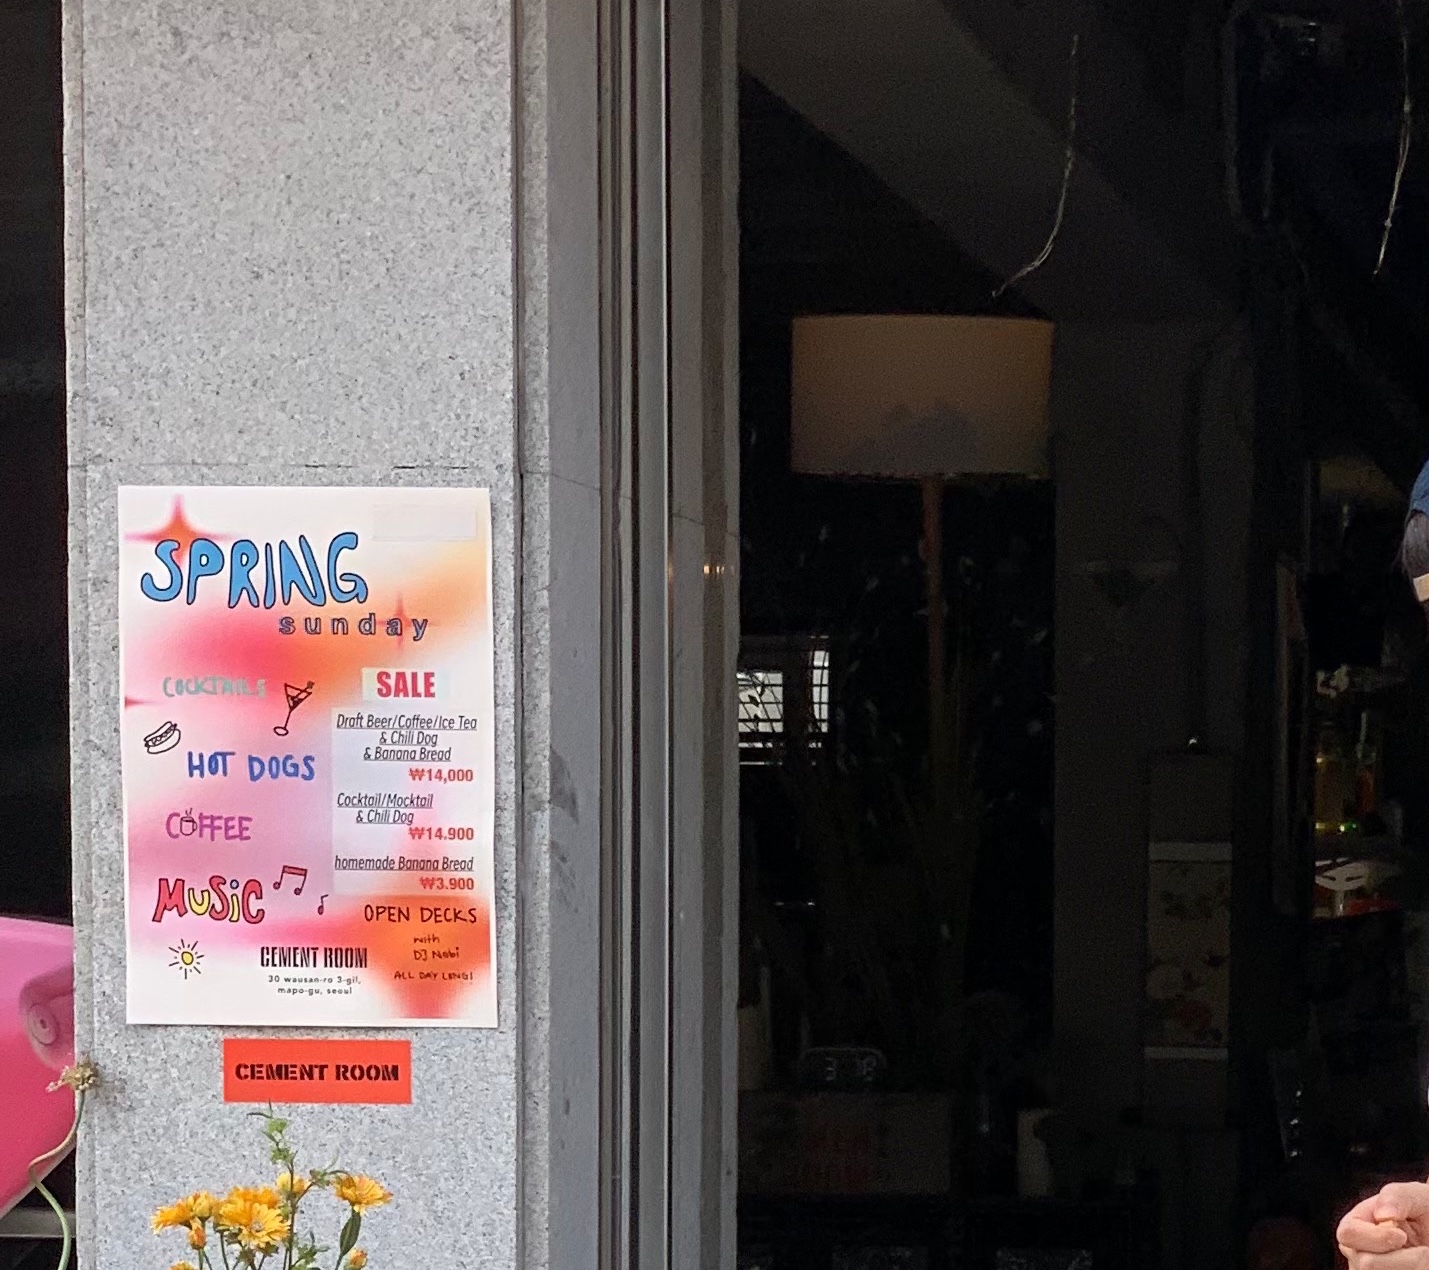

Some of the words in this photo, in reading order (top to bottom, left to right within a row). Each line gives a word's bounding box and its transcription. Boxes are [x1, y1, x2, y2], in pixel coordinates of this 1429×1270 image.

[140, 532, 368, 609] SPRING
[279, 612, 428, 641] sunday
[376, 671, 435, 698] SALE
[337, 711, 363, 729] Draft
[458, 715, 478, 730] Tea
[379, 731, 387, 743] &
[391, 730, 413, 744] Chili
[416, 731, 438, 747] Dog
[363, 747, 372, 760] &
[375, 747, 416, 761] Banana
[419, 747, 452, 761] Bread
[187, 751, 236, 779] HOT
[248, 754, 315, 782] DOGS
[337, 792, 434, 808] Cocktail/Mocktail
[356, 809, 363, 823] &
[367, 809, 390, 823] Chili
[393, 809, 414, 826] Dog
[334, 855, 396, 870] homemade
[398, 856, 439, 870] Banana
[442, 857, 474, 871] Bread
[364, 904, 410, 922] OPEN
[420, 907, 477, 924] DECKS
[260, 946, 319, 968] CEMENT
[323, 947, 368, 968] ROOM
[413, 949, 428, 961] DJ
[268, 975, 280, 983] 30
[393, 970, 415, 980] ALL
[418, 970, 438, 980] DAY
[326, 986, 353, 995] seoul
[234, 1062, 330, 1083] CEMENT
[335, 1063, 400, 1083] ROOM
